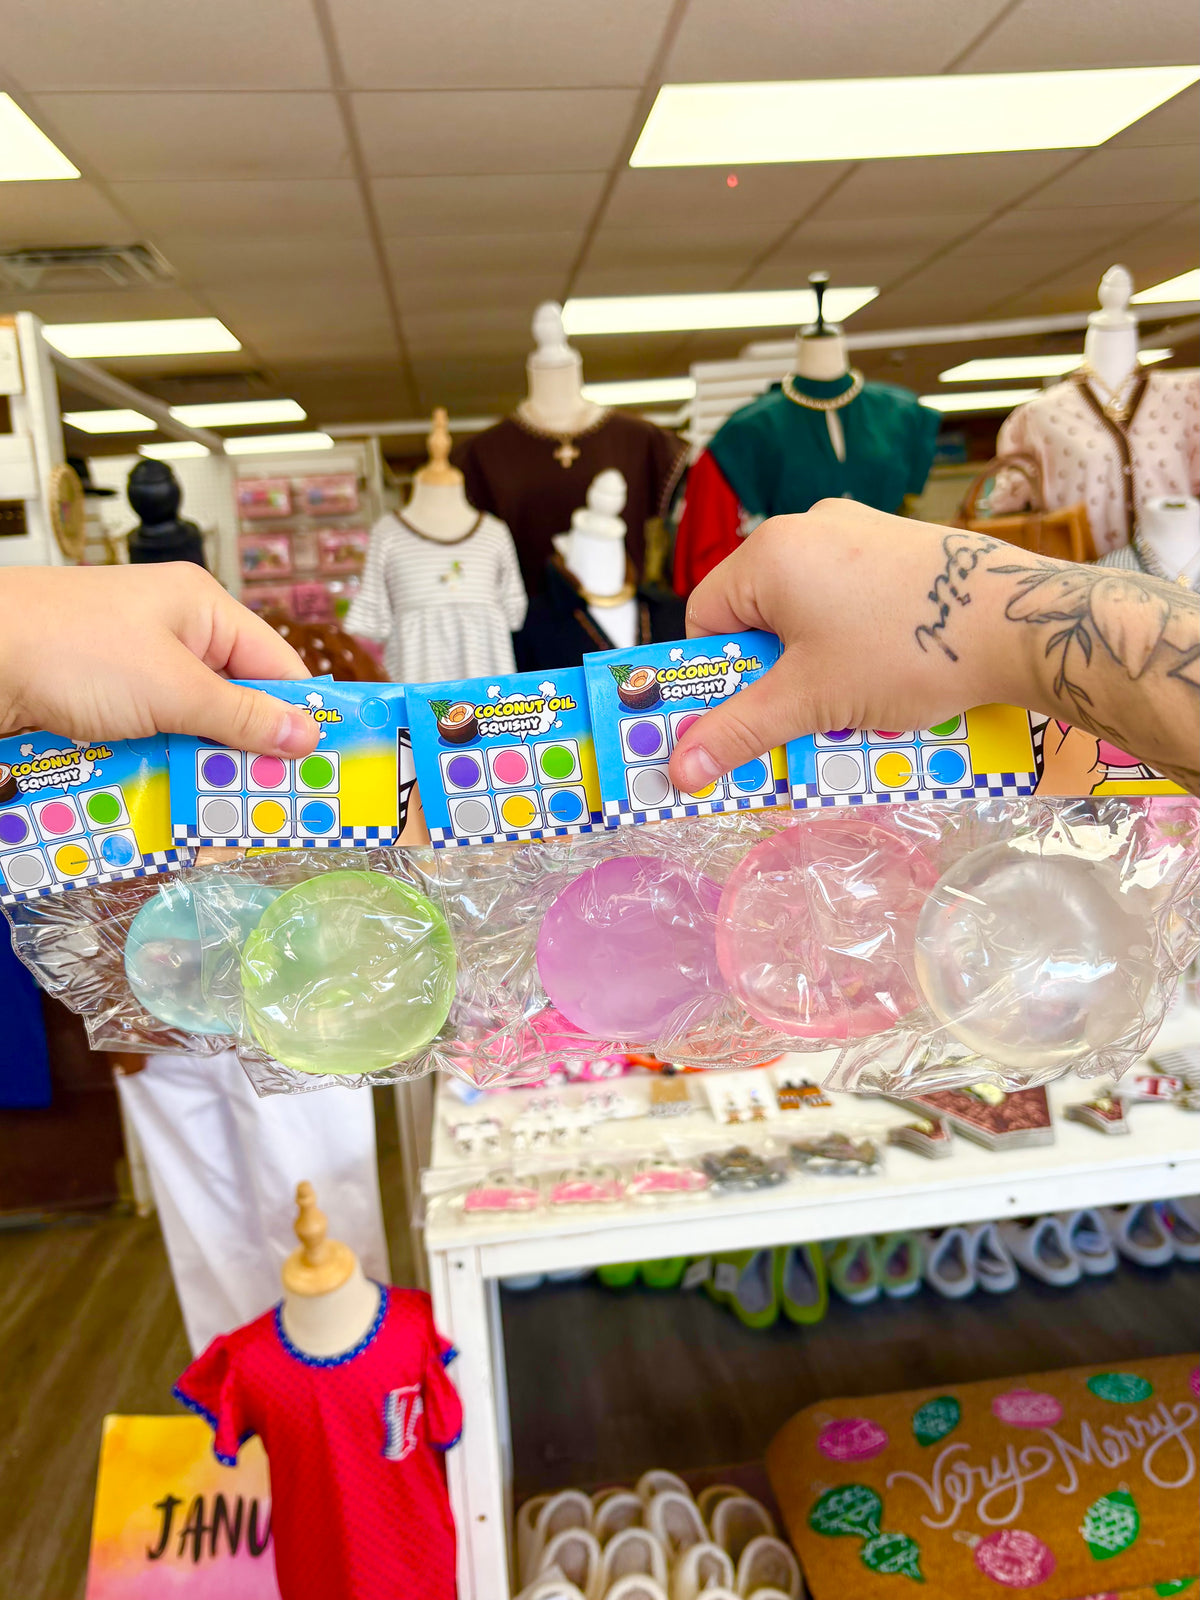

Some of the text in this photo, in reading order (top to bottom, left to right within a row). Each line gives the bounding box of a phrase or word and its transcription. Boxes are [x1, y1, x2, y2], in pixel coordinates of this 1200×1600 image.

[656, 656, 763, 683] COCONUT OIL
[661, 679, 726, 701] SQUISHY
[314, 708, 343, 722] OIL
[474, 695, 577, 719] COCONUT OIL
[479, 716, 541, 736] SQUISHY
[10, 745, 113, 777] COCONUT OIL
[18, 768, 80, 793] SQUISHY
[886, 1401, 1199, 1529] Very Merry
